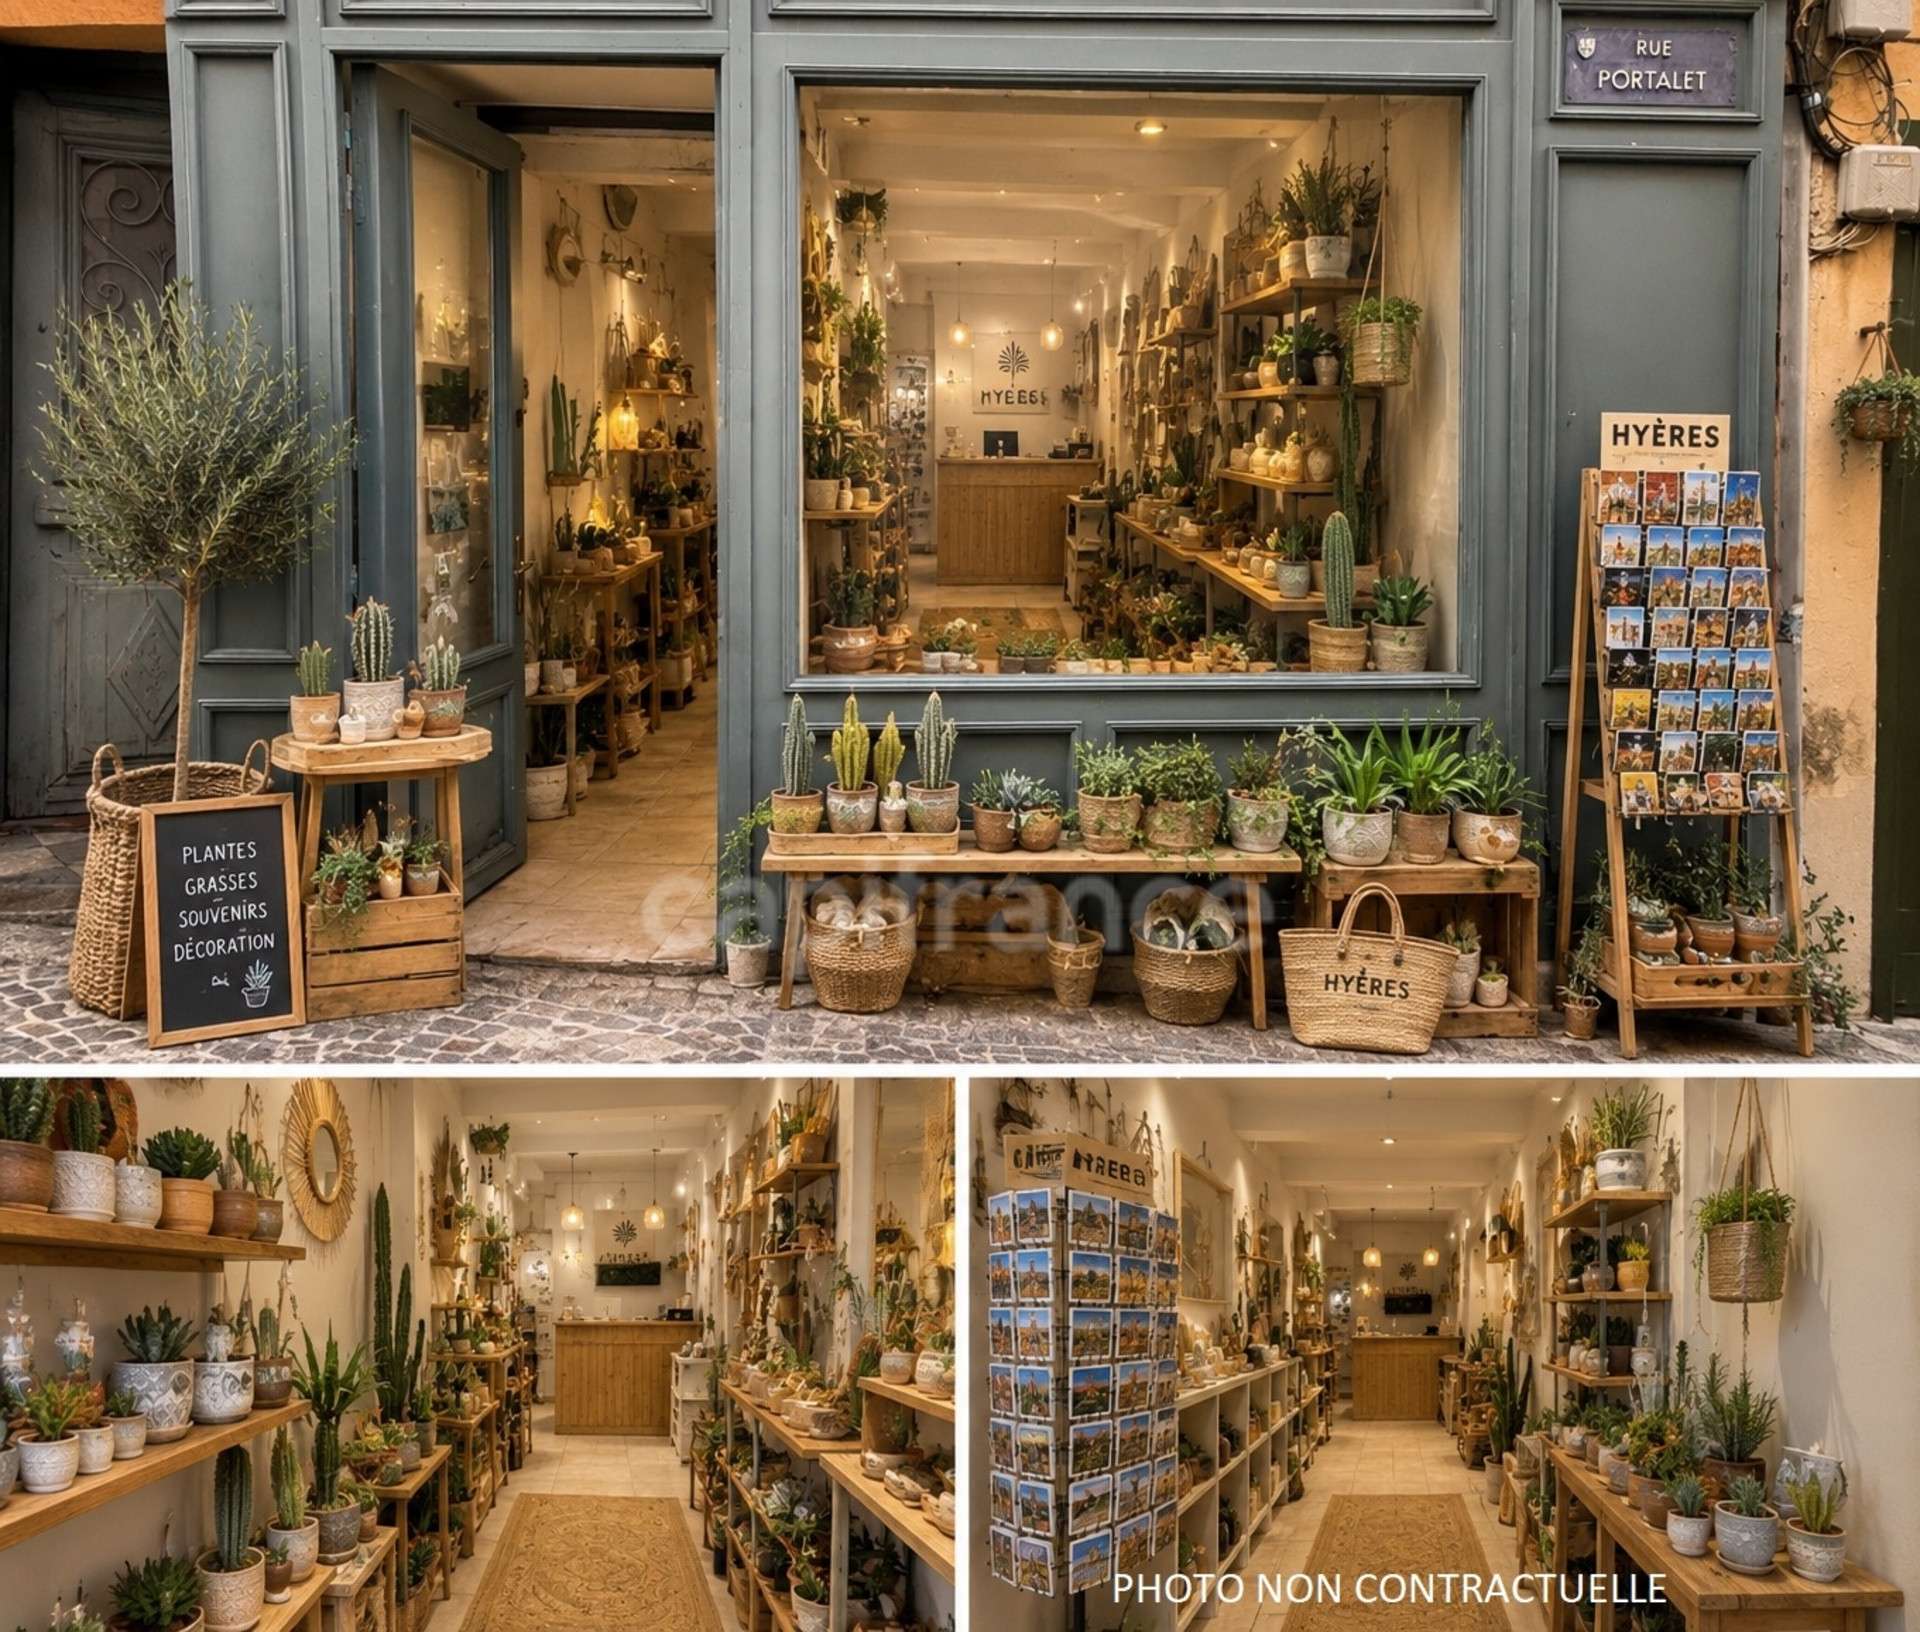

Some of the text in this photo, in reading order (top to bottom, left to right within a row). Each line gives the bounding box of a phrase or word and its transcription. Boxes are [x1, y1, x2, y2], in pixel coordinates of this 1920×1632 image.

[1636, 39, 1673, 57] RUE
[1598, 69, 1707, 90] PORTALET
[1612, 417, 1719, 448] HYÈRES
[182, 841, 257, 865] PLANTES
[184, 871, 258, 896] GRASSES
[173, 932, 275, 963] DÉCORATION
